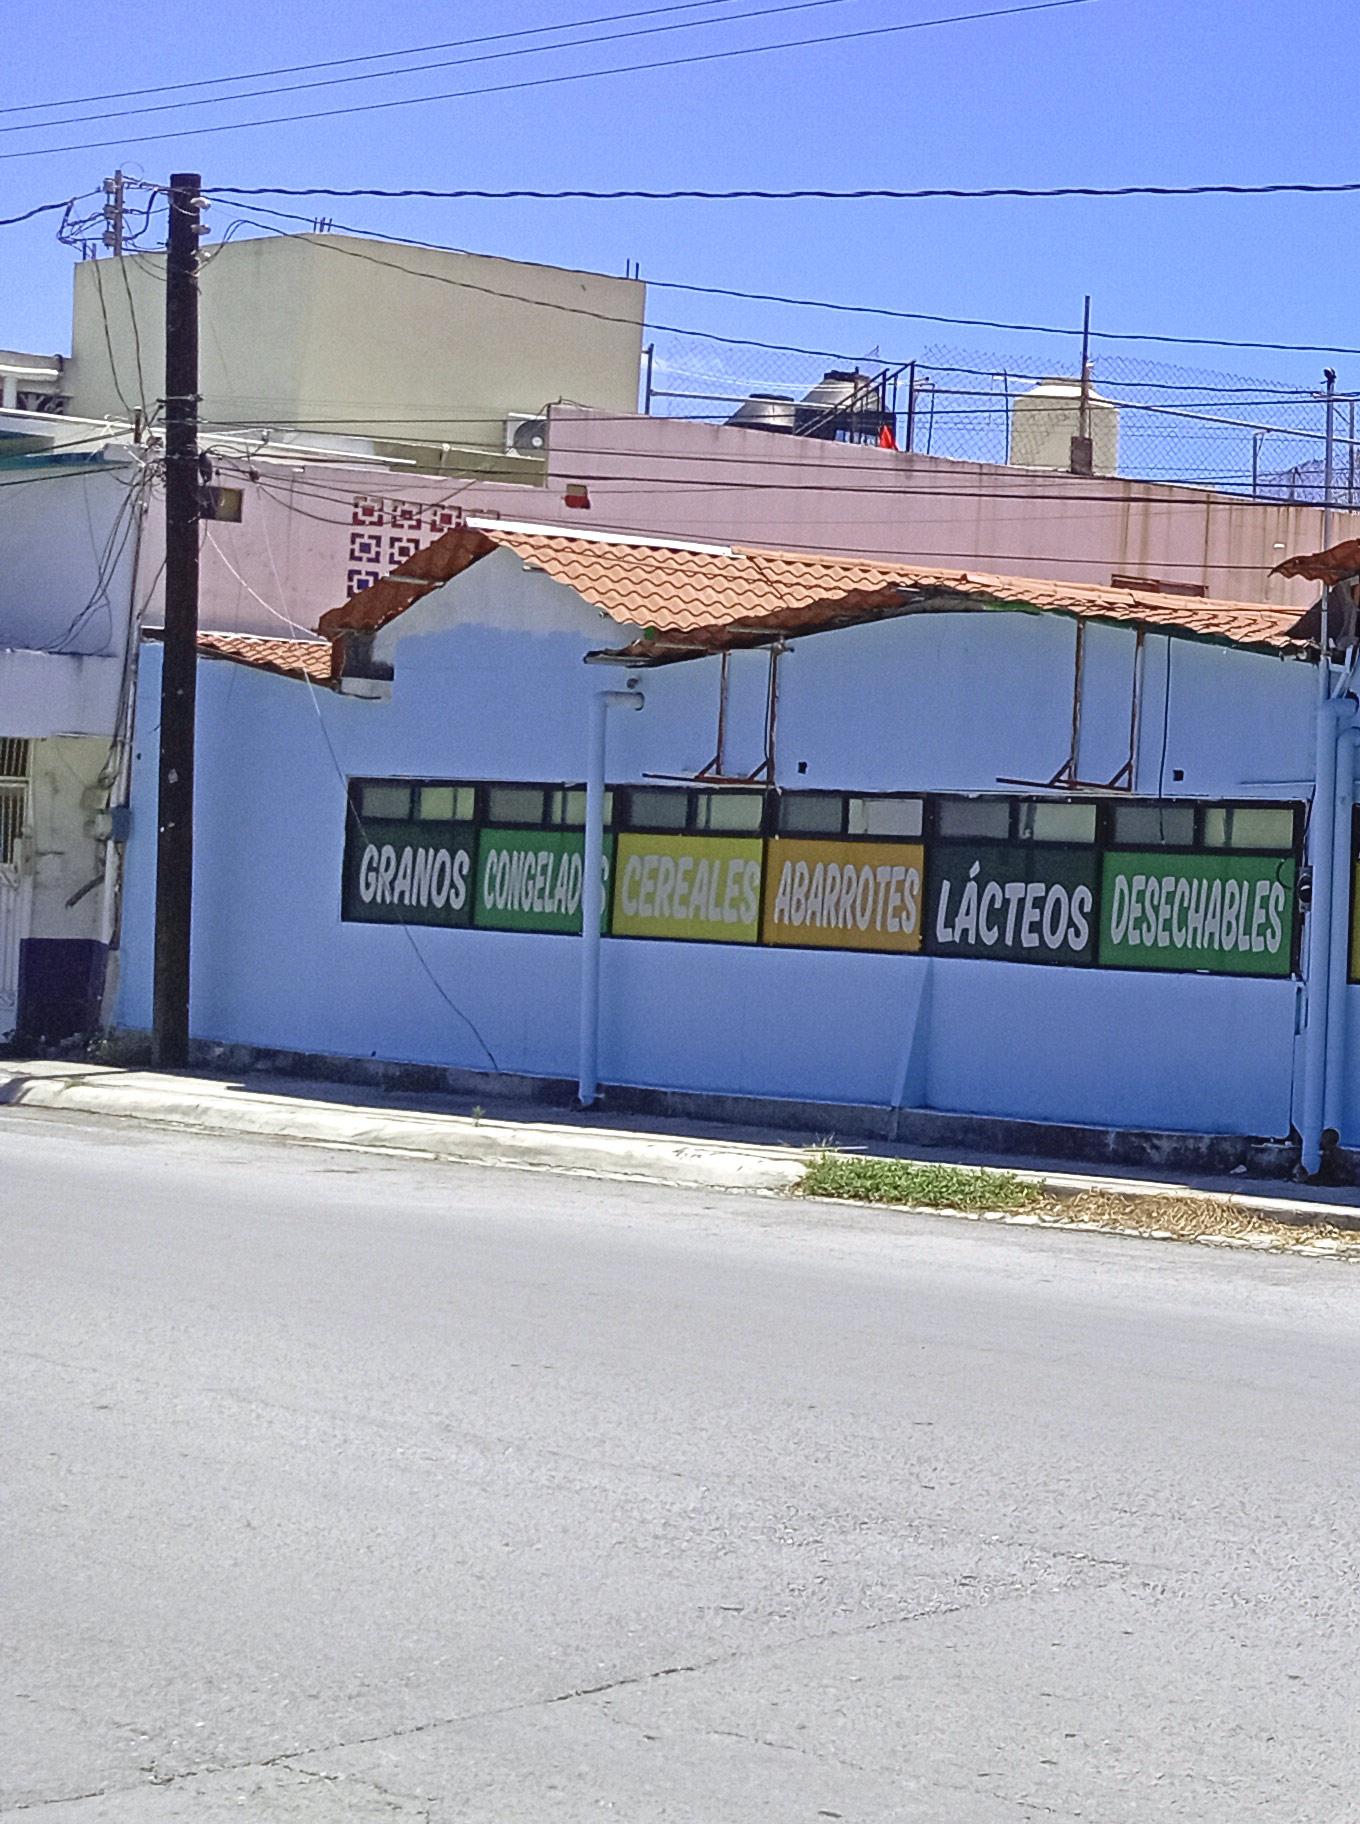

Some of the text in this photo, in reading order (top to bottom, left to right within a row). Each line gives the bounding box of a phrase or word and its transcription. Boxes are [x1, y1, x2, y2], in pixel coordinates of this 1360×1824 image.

[360, 843, 470, 910] GRANOS
[484, 849, 609, 915] CONGELADS
[622, 855, 761, 924] CEREALES
[773, 860, 920, 934] ABARROTES
[935, 860, 1093, 952] LÁCTEOS
[1111, 874, 1285, 954] DESECHABLES
